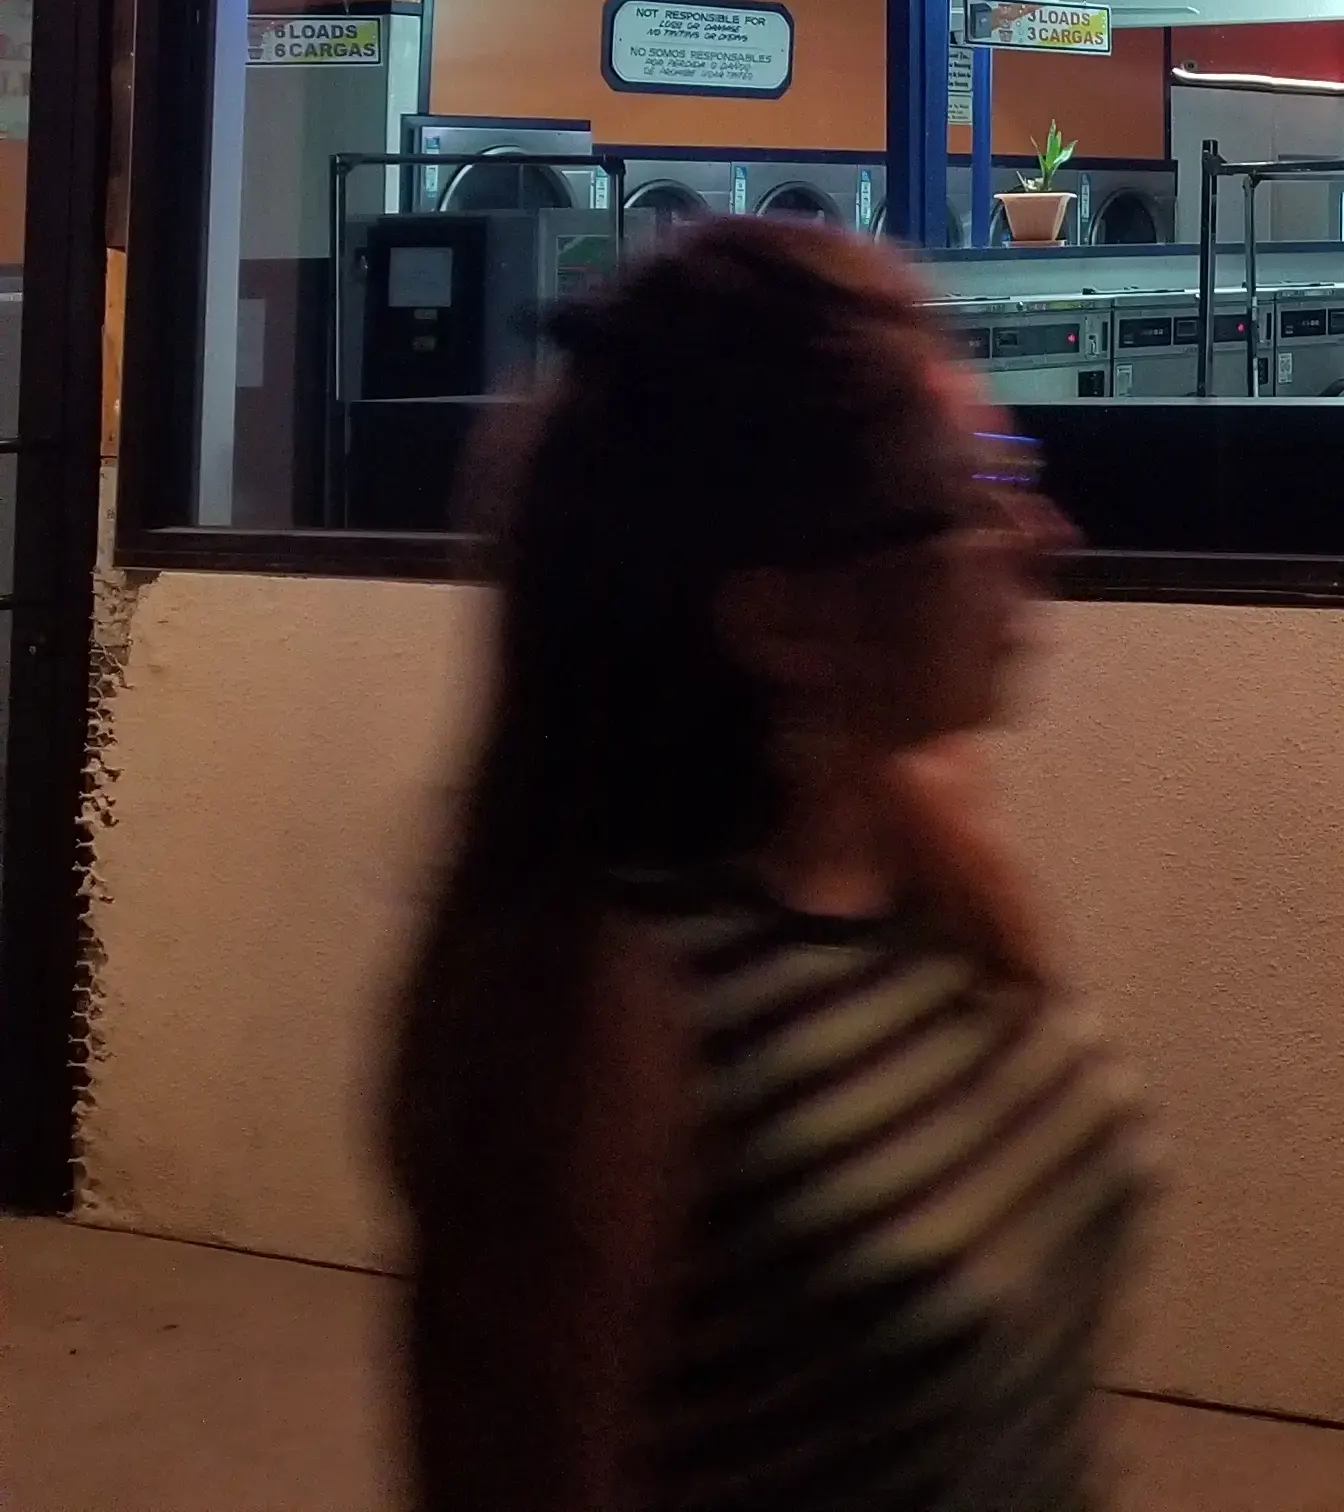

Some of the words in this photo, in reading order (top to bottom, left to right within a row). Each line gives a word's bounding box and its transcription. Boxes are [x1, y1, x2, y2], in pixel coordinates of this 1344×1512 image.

[636, 7, 659, 19] NOT
[665, 10, 740, 25] RESPONSIBLE
[745, 16, 766, 27] FOR
[1027, 9, 1036, 22] 3
[1039, 10, 1090, 26] LOADS
[274, 24, 286, 39] 6
[289, 24, 358, 39] LOADS
[1027, 26, 1036, 41] 3
[1039, 28, 1104, 45] CARGAS
[274, 43, 286, 58] 6
[289, 43, 375, 58] CARGAS
[630, 46, 646, 57] NO
[648, 48, 686, 58] SOMOS
[691, 50, 772, 64] RESPONSABLES
